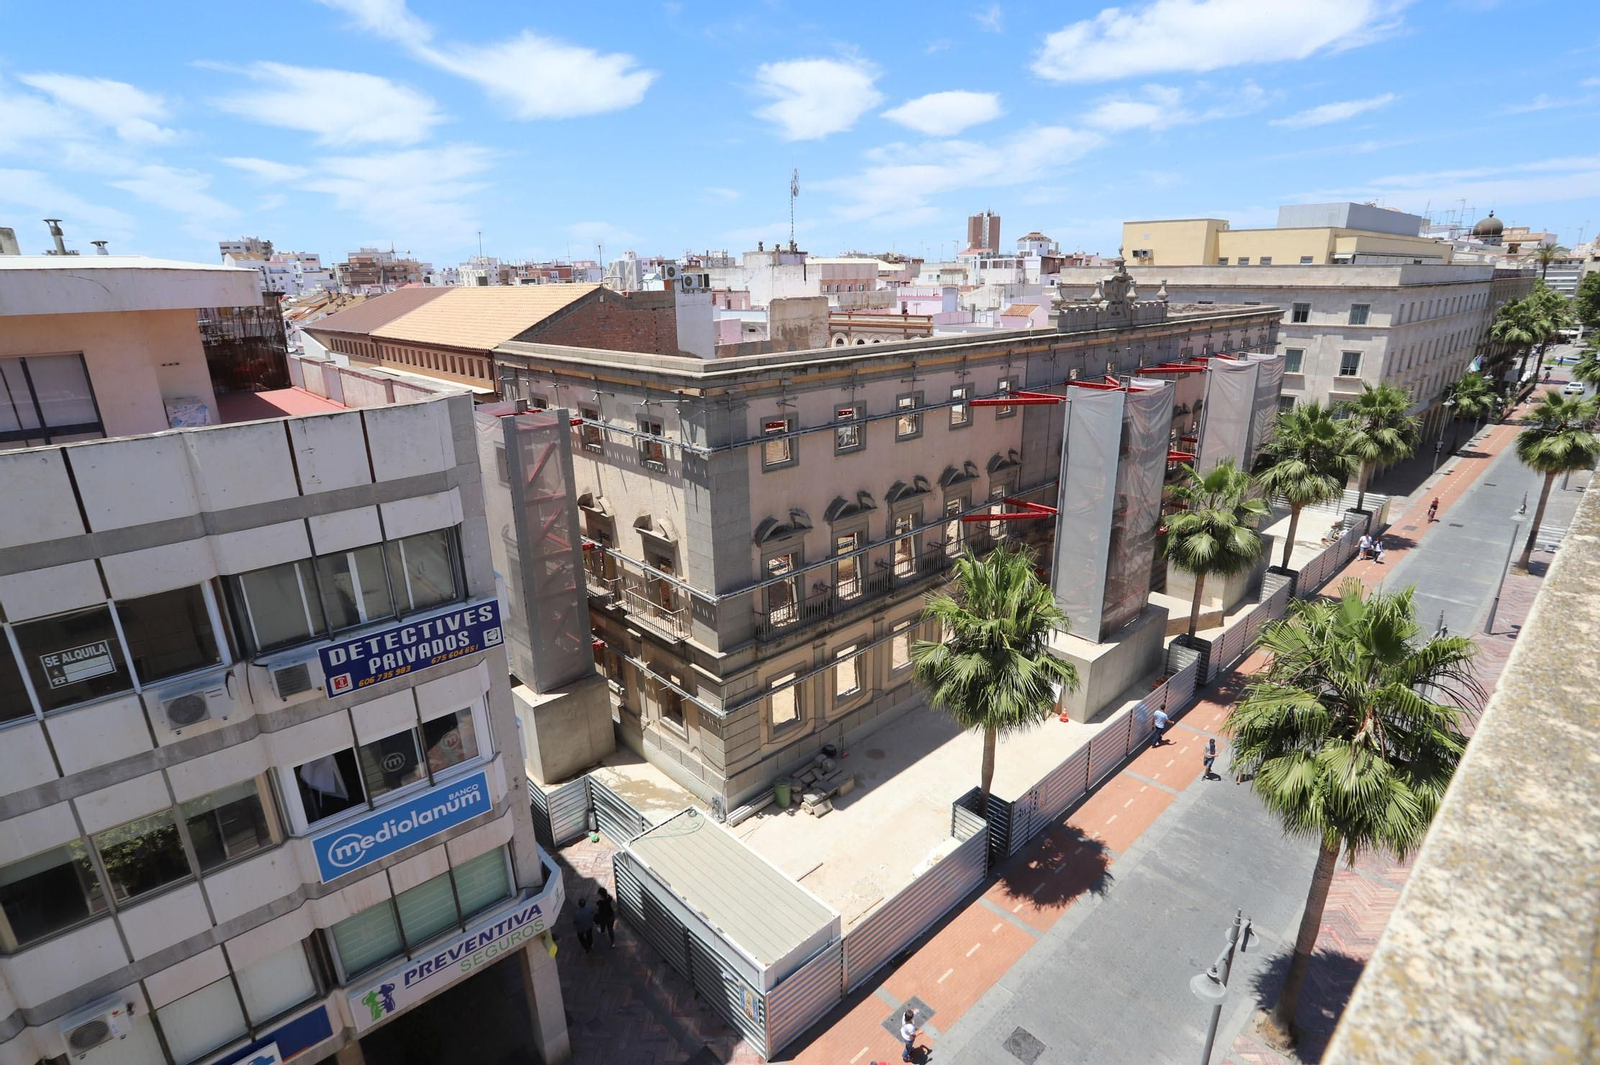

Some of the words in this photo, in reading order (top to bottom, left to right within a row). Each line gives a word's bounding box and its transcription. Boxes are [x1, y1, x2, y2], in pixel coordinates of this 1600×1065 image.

[44, 655, 60, 668] SE
[62, 644, 107, 663] ALQUILA
[328, 605, 493, 667] DETECTIVES
[368, 630, 470, 675] PRIVADOS
[431, 654, 447, 664] 675
[448, 649, 463, 659] 604
[464, 644, 479, 654] 651
[358, 676, 375, 687] 606
[377, 670, 393, 682] 735
[448, 783, 479, 800] BANCO
[328, 789, 481, 867] mediolanum
[404, 904, 542, 986] PREVENTIVA
[460, 919, 545, 972] SEGUROS
